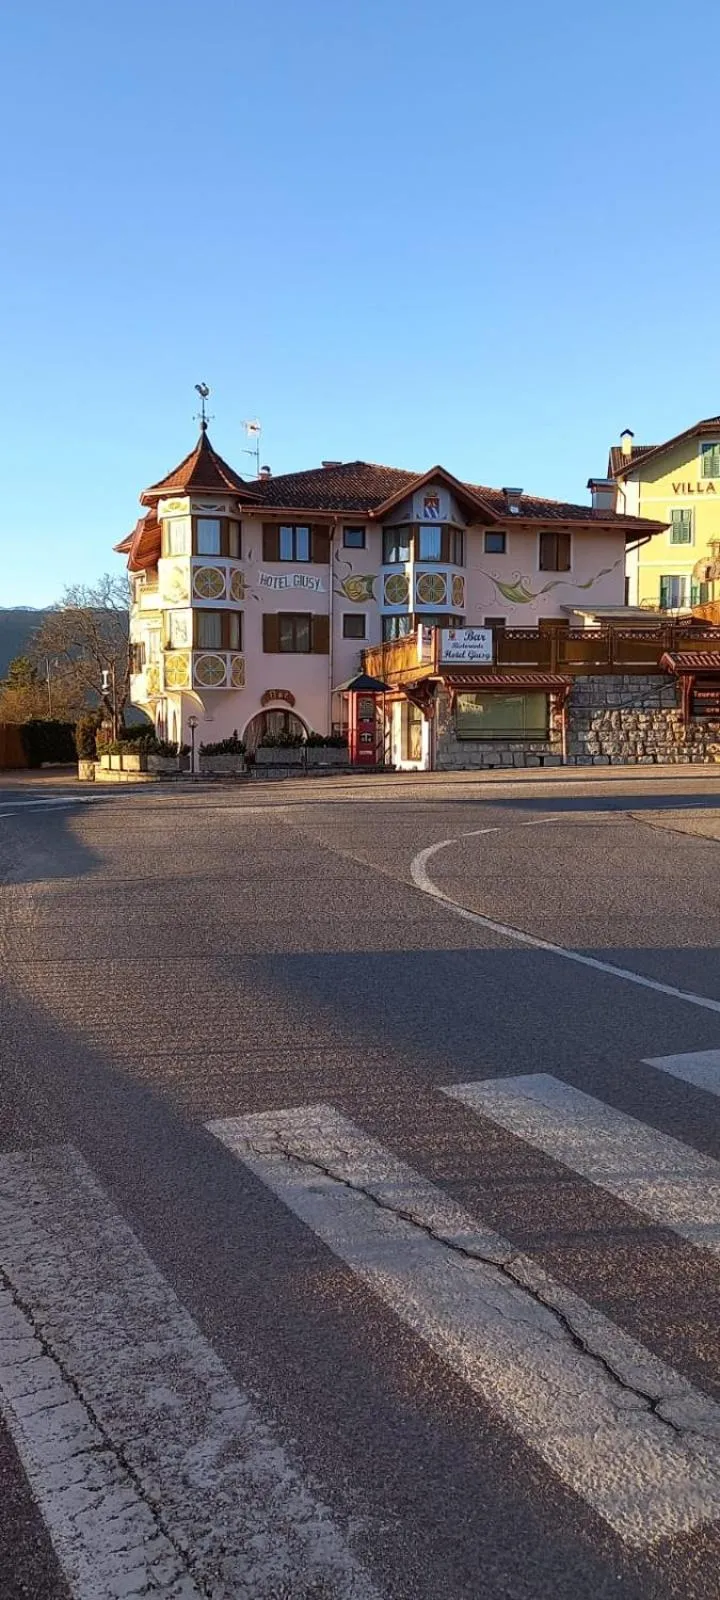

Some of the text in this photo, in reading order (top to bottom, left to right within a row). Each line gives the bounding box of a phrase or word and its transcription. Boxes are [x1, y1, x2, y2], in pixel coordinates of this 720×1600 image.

[671, 482, 716, 494] VILLA
[260, 573, 321, 590] HOTEL GIUSY
[464, 630, 486, 641] Bar
[445, 650, 466, 658] Hotel
